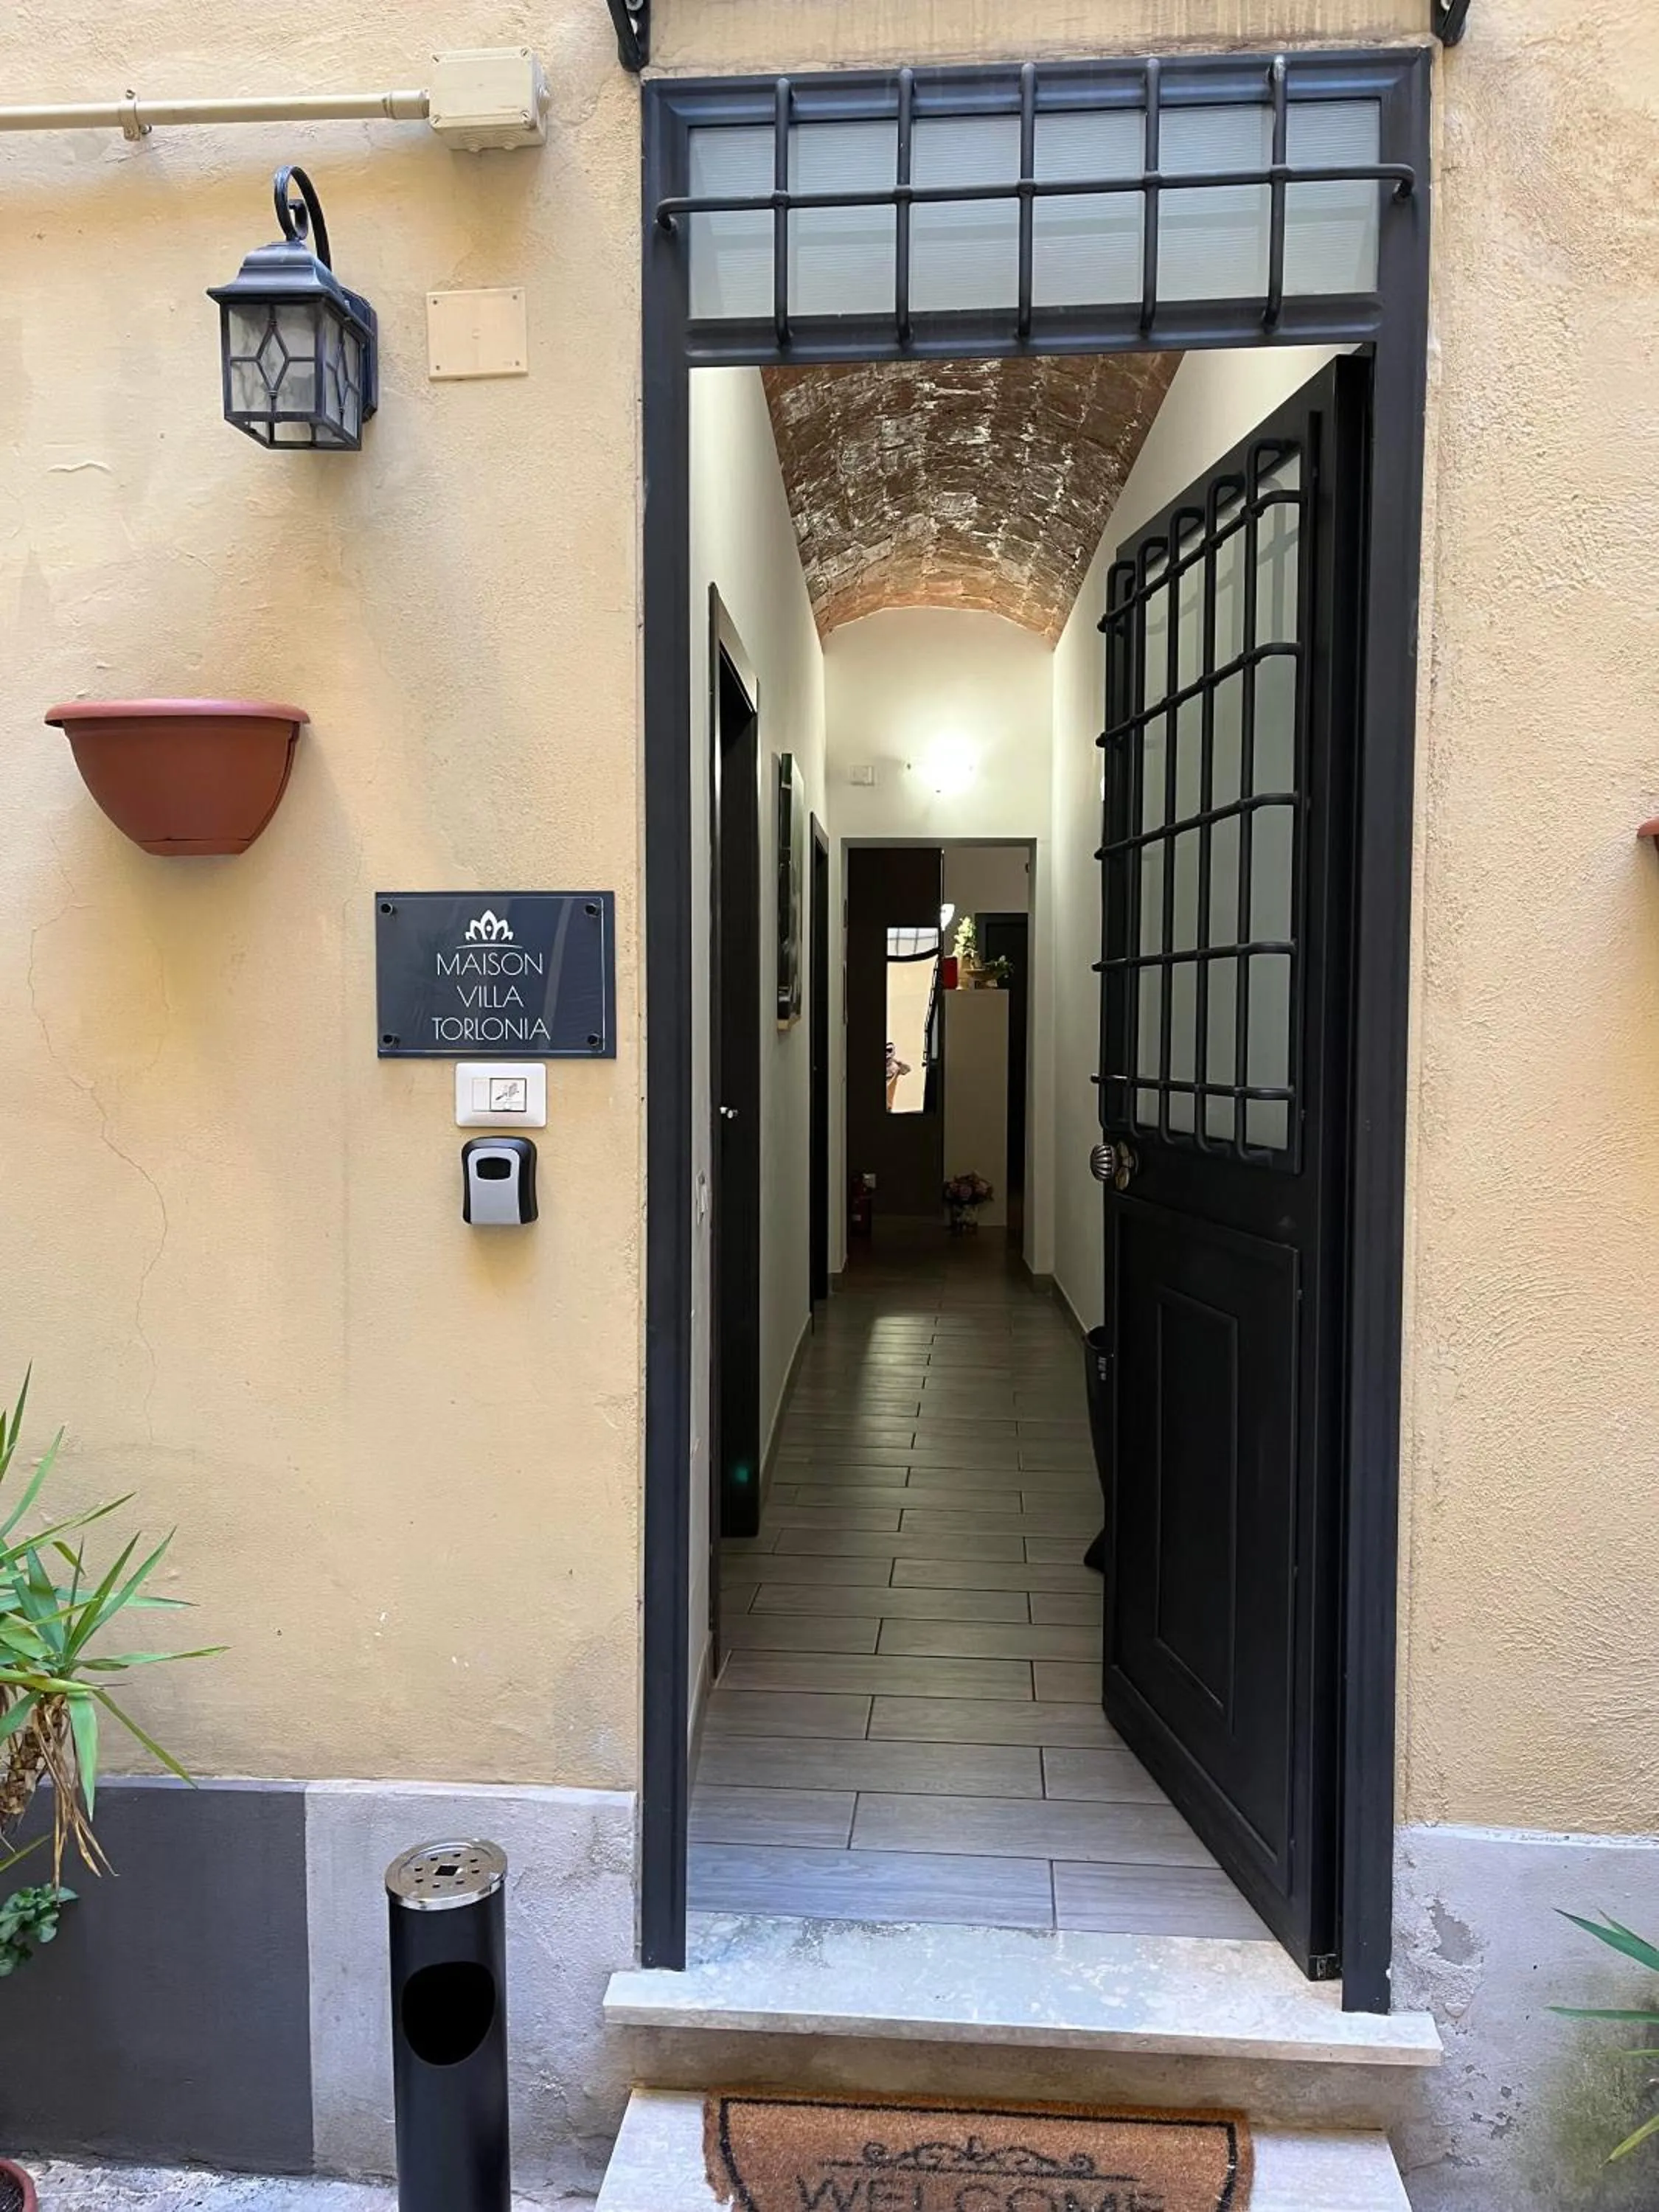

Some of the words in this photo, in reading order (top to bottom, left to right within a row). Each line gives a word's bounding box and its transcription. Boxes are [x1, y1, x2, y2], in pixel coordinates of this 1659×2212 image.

[437, 953, 543, 975] MAISON
[456, 985, 524, 1008] VILLA
[431, 1017, 551, 1040] TORLONIA
